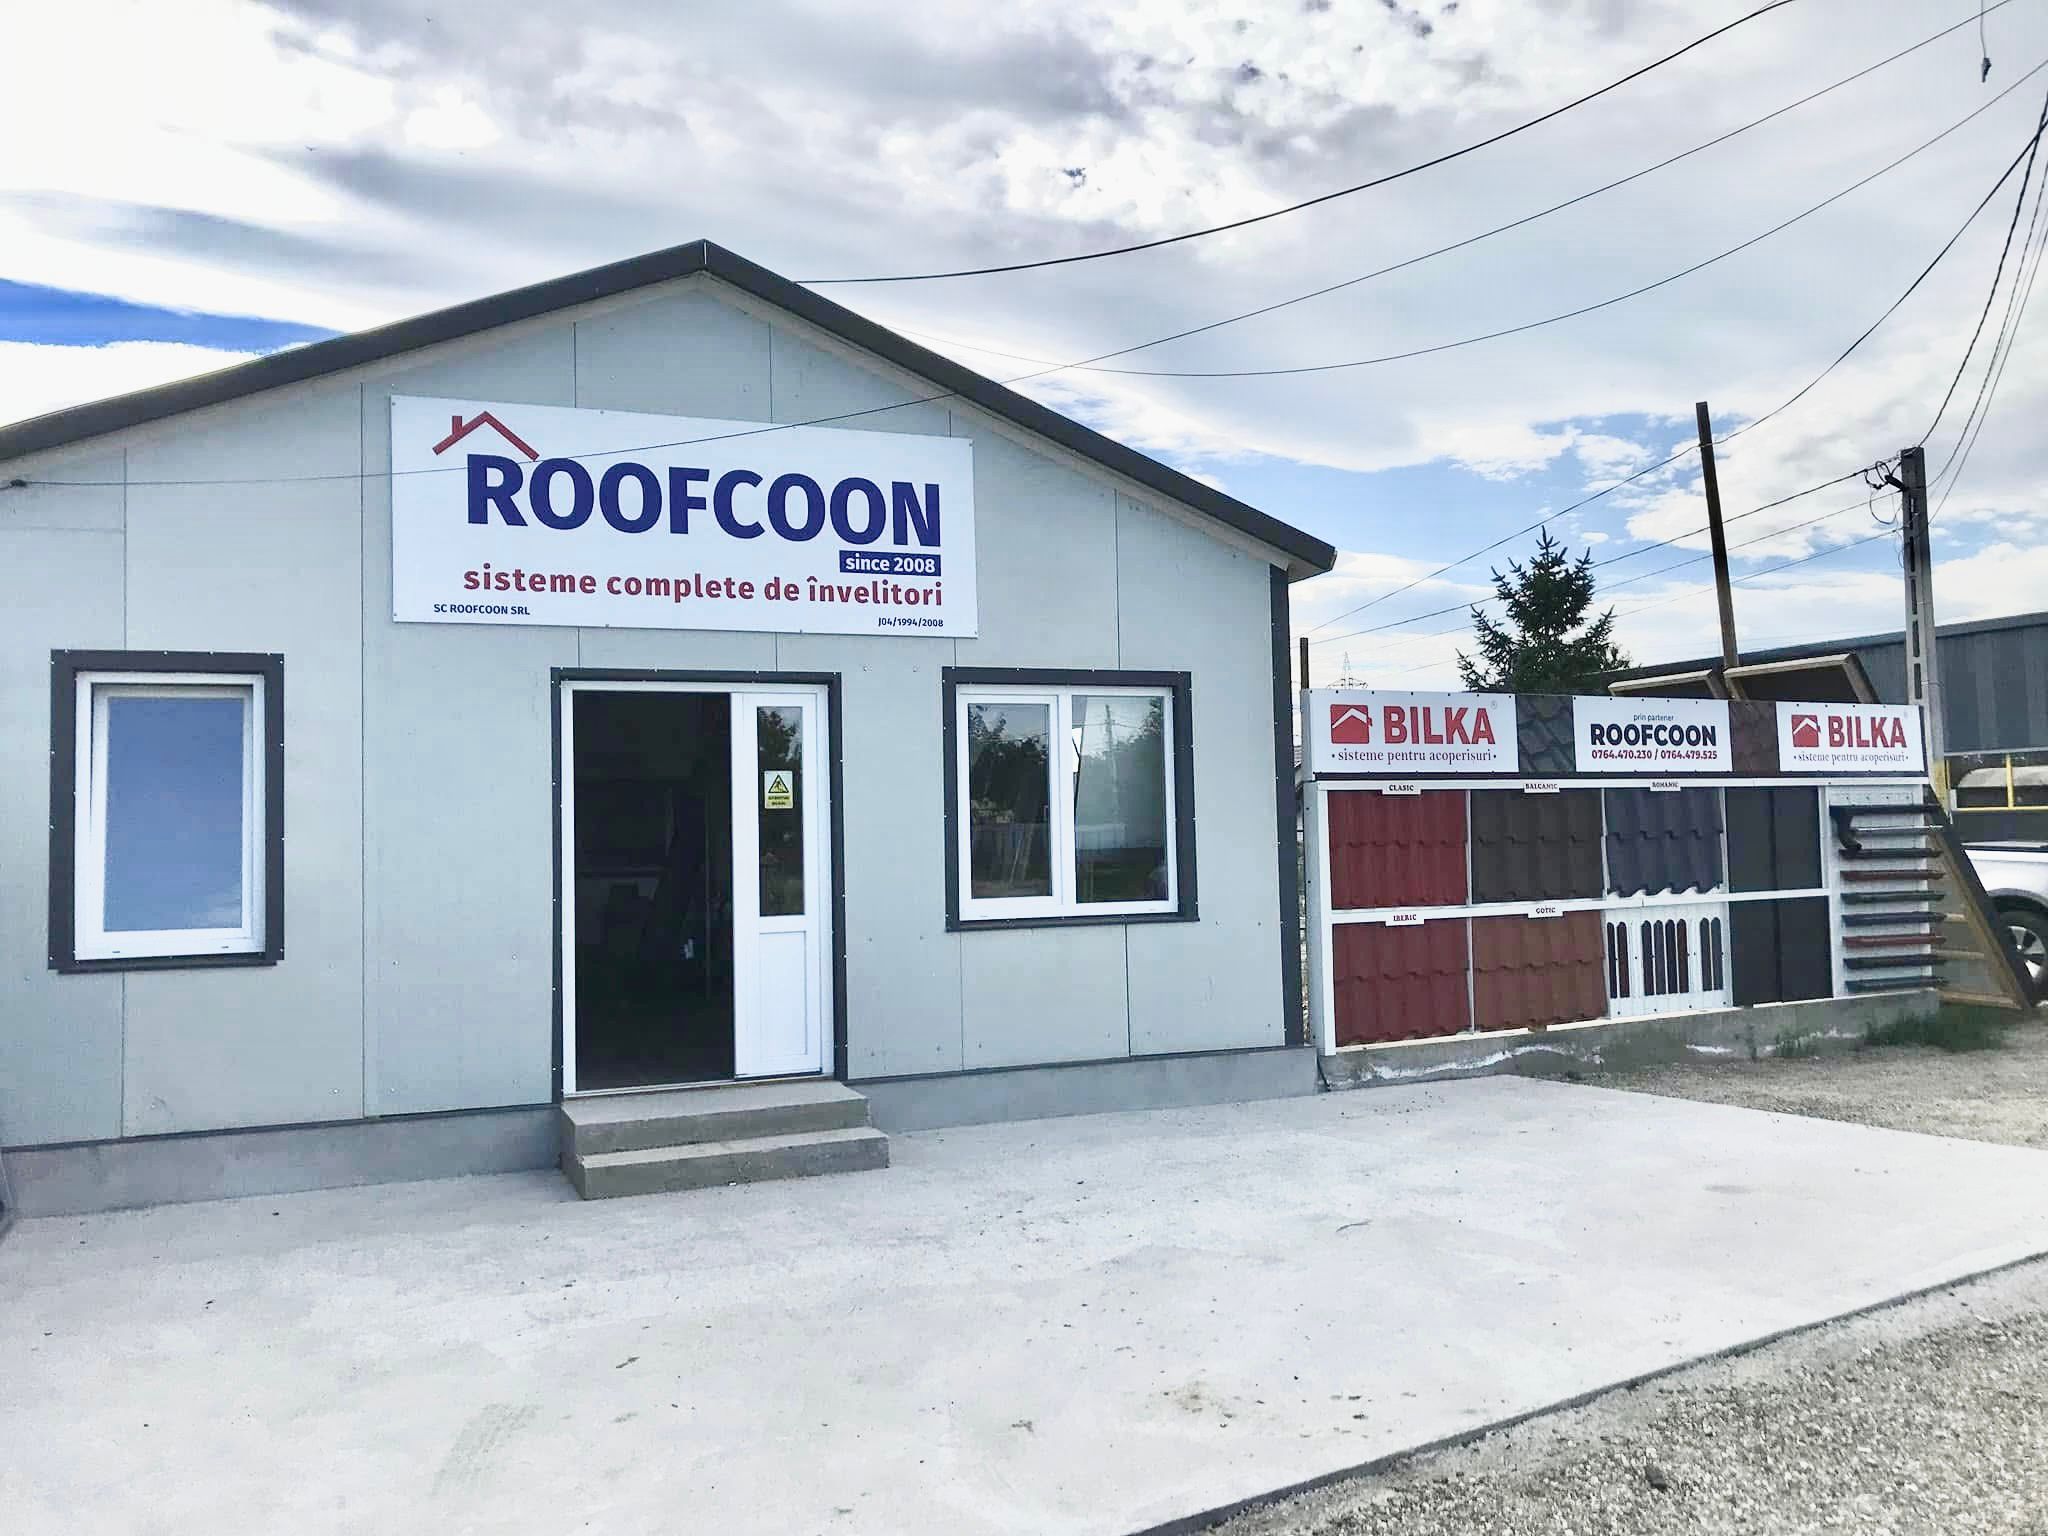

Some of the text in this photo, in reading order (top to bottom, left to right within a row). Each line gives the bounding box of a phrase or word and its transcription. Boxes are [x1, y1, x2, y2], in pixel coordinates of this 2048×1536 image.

[467, 453, 941, 547] ROOFCOON
[845, 553, 936, 574] since 2008
[463, 562, 942, 606] sisteme complete de învelitori
[433, 602, 530, 616] SC ROOFCOON SRL
[878, 617, 944, 628] J04/1994/2008
[1383, 705, 1496, 745] BILKA
[1633, 712, 1674, 722] prin partener
[1590, 723, 1717, 747] ROOFCOON
[1828, 715, 1908, 748] BILKA
[1337, 747, 1492, 765] sisteme pentru acoperisuri
[1591, 749, 1652, 760] 0764.470.230
[1798, 751, 1830, 762] sisteme
[1831, 752, 1858, 766] pentru
[1388, 784, 1414, 792] CLASIC
[1525, 783, 1558, 791] BALCANIC
